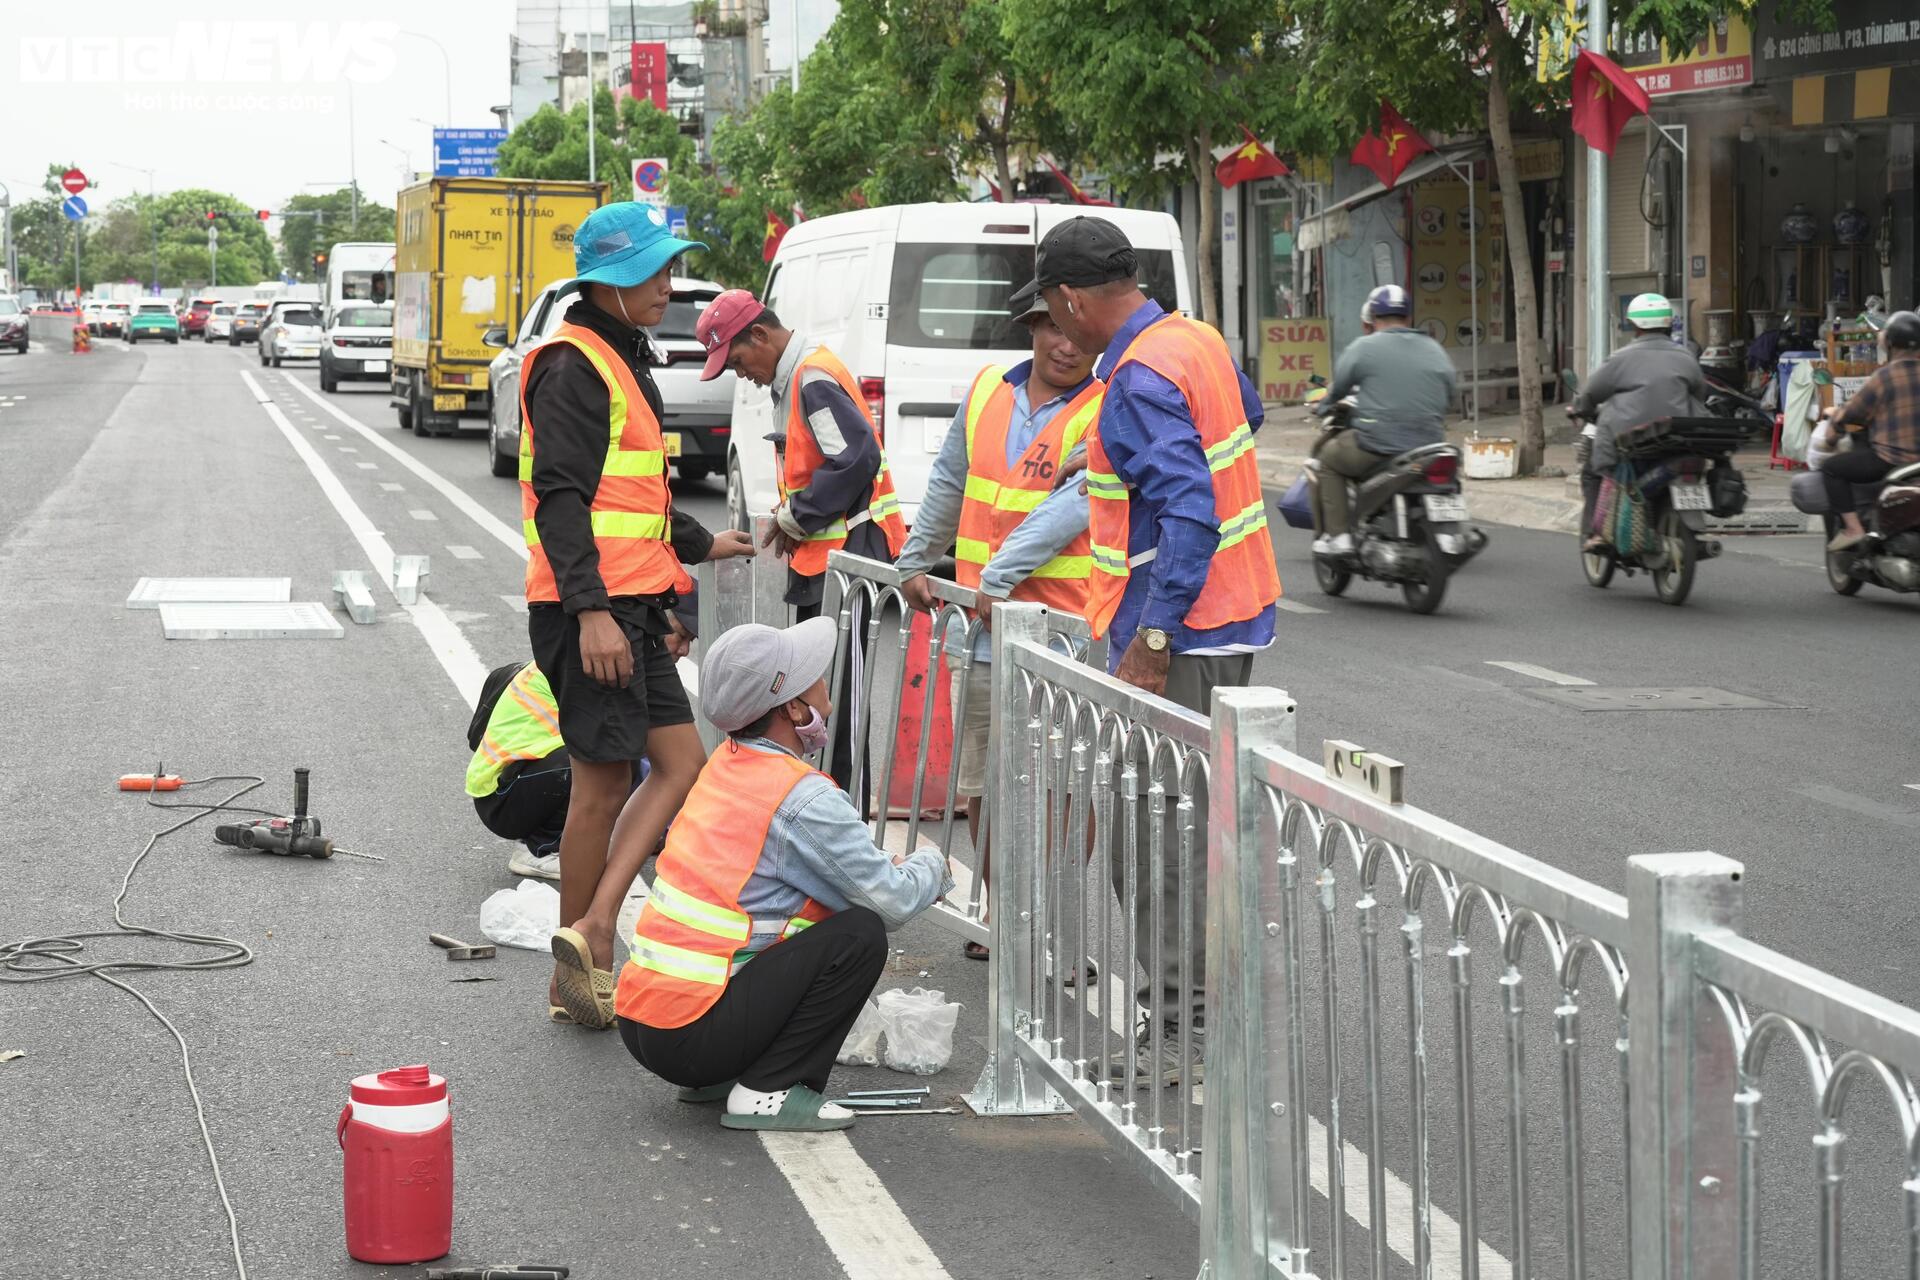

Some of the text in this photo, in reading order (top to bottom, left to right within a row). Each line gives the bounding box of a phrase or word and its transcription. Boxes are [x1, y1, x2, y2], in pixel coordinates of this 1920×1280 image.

[1779, 38, 1797, 58] 624
[490, 207, 503, 217] XE
[1279, 354, 1314, 371] XE
[1036, 443, 1049, 461] 7
